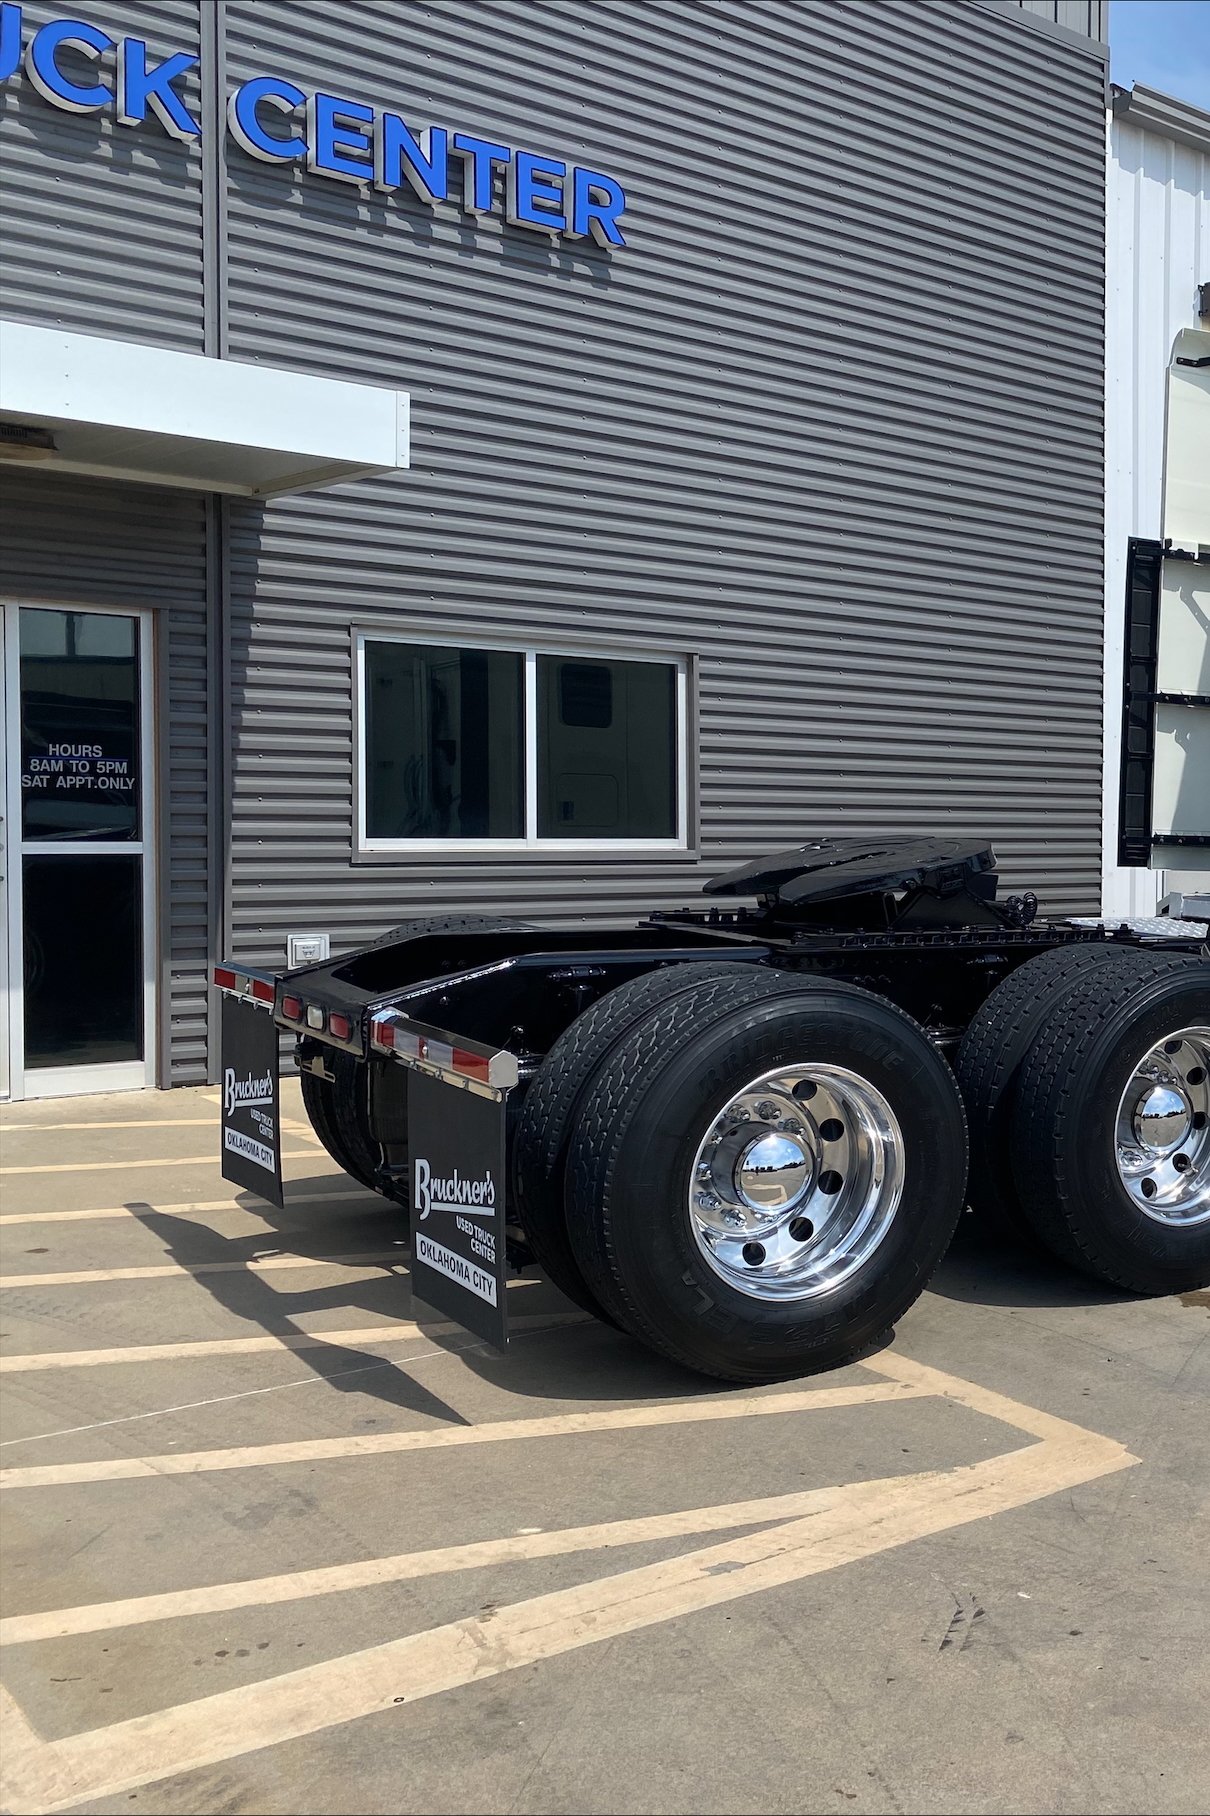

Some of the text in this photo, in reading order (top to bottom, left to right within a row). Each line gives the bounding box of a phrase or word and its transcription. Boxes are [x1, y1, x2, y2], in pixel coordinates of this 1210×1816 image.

[227, 76, 626, 249] CENTER
[29, 758, 128, 774] 8AM TO 5PM
[48, 743, 103, 758] HOURS
[21, 774, 50, 788] SAT
[694, 1022, 905, 1098] BRIDGESTONE
[1097, 1001, 1183, 1106] YOKOHAMA
[224, 1067, 273, 1117] Bruckner's
[250, 1107, 274, 1129] USED TRUCK
[259, 1123, 274, 1140] CENTER
[227, 1132, 273, 1166] OKLAHOMA CITY
[415, 1158, 495, 1220] Bruckner's
[456, 1215, 496, 1250] USED TRUCK
[420, 1240, 493, 1296] OKLAHOMA CITY
[470, 1238, 496, 1265] CENTER
